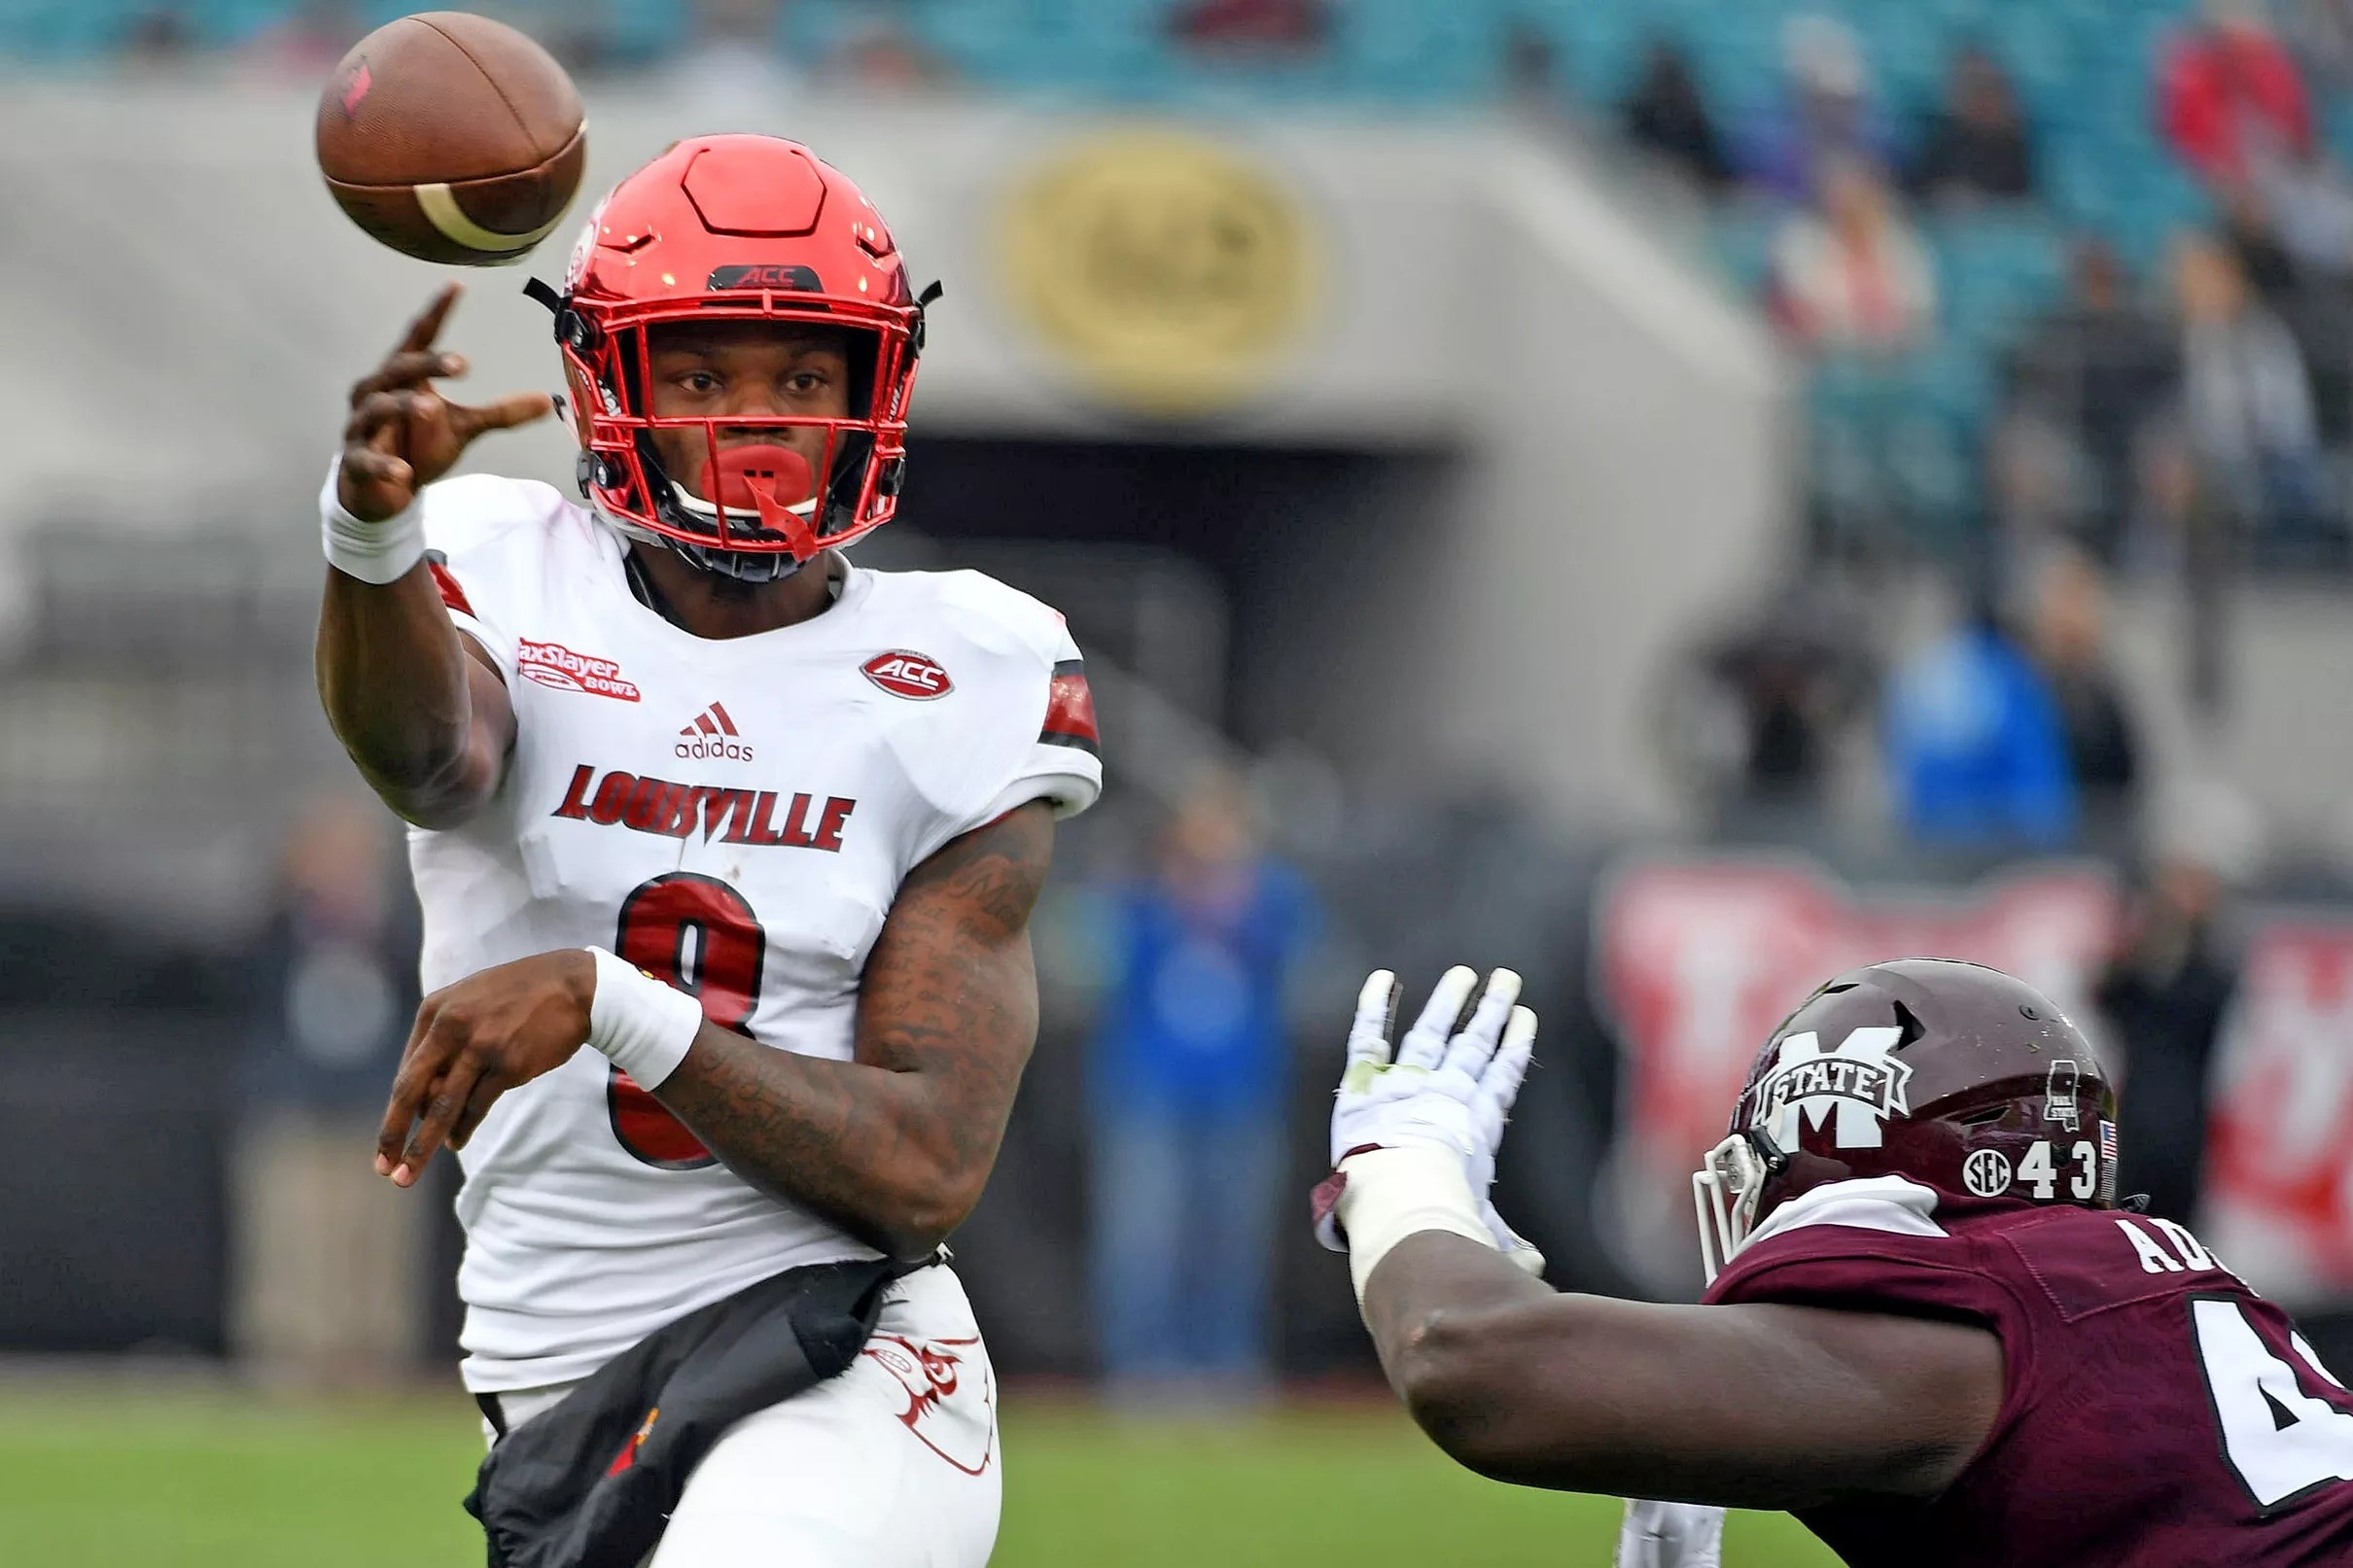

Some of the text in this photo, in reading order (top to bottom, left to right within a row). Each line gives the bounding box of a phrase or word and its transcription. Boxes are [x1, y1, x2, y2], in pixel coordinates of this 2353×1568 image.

[733, 268, 796, 289] ACC
[584, 677, 638, 697] BOWL
[873, 659, 944, 687] ACC
[675, 736, 754, 762] adidas
[551, 764, 857, 853] LOUISVILLE
[1773, 1062, 1878, 1102] STATE
[1967, 1151, 2009, 1195] SEC
[2018, 1141, 2096, 1199] 43
